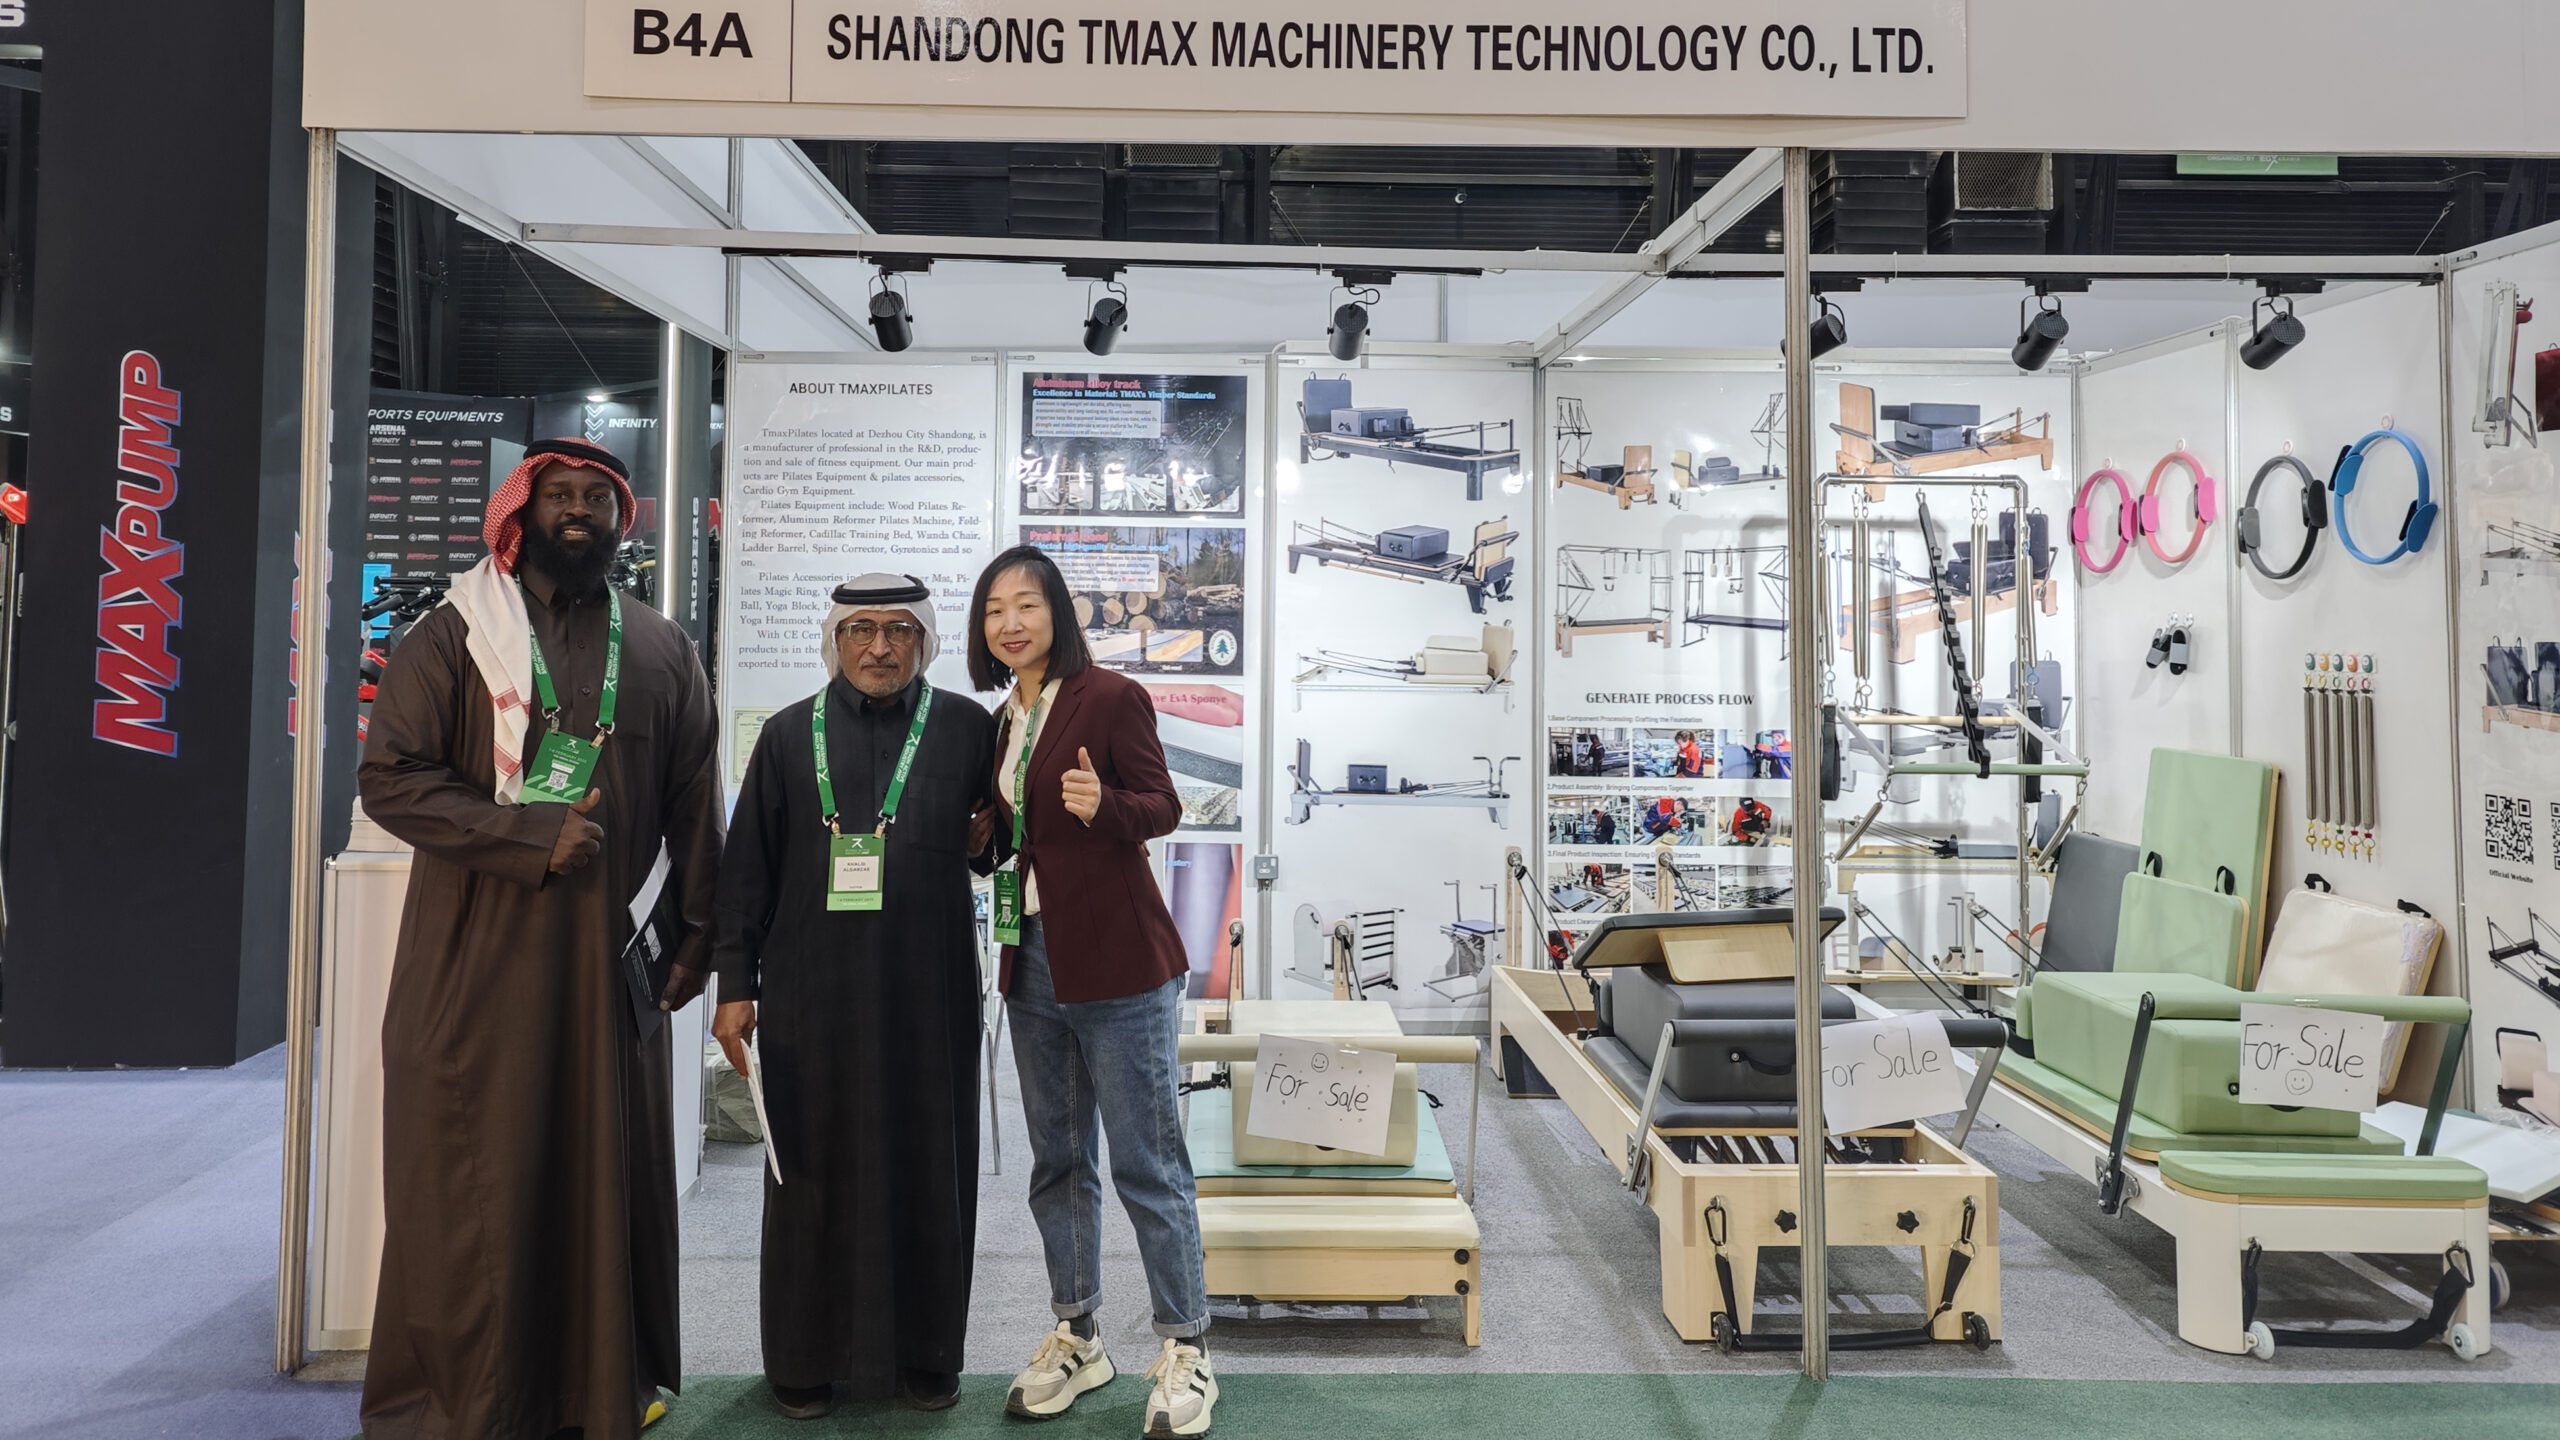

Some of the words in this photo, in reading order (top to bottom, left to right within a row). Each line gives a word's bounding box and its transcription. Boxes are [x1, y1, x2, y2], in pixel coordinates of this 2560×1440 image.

[633, 8, 753, 58] B4A
[826, 14, 1064, 64] SHANDONG
[1078, 18, 1199, 67] TMAX
[1212, 21, 1453, 71] MACHINERY
[1466, 23, 1747, 72] TECHNOLOGY
[1760, 23, 1837, 79] CO.,
[1851, 26, 1934, 74] LTD.
[789, 382, 834, 395] ABOUT
[839, 383, 933, 395] TMAXPILATES
[1033, 389, 1073, 397] Excellence
[1176, 391, 1216, 400] Standards
[368, 409, 413, 420] PORTS
[416, 411, 504, 422] EQUIPMENTS
[609, 418, 657, 428] INFINITY
[762, 428, 817, 437] TmaxPilates
[822, 429, 853, 438] located
[856, 430, 864, 438] at
[869, 430, 902, 438] Dezhou
[906, 430, 925, 440] City
[928, 430, 976, 440] Shandong,
[753, 443, 813, 452] manufacturer
[817, 444, 826, 452] of
[829, 444, 882, 454] professional
[899, 445, 914, 453] the
[918, 445, 944, 454] R&D,
[947, 445, 981, 454] produc-
[744, 457, 761, 466] tion
[765, 458, 782, 466] and
[785, 458, 802, 466] sale
[806, 458, 816, 466] of
[818, 458, 847, 466] fitness
[850, 460, 901, 468] equipment.
[904, 459, 923, 467] Our
[953, 459, 976, 469] prod-
[743, 473, 761, 481] ucts
[783, 472, 812, 481] Pilates
[817, 472, 866, 483] Equipment
[870, 473, 878, 481] &
[881, 473, 911, 483] pilates
[914, 474, 965, 483] accessories,
[743, 485, 774, 495] Cardio
[777, 486, 798, 497] Gym
[803, 486, 855, 497] Equipment.
[761, 500, 791, 509] Pilates
[795, 501, 845, 511] Equipment
[848, 501, 885, 510] include:
[888, 501, 914, 510] Wood
[918, 501, 948, 510] Pilates
[952, 502, 966, 510] Re-
[742, 515, 776, 525] former,
[779, 515, 828, 524] Aluminum
[833, 515, 875, 524] Reformer
[880, 516, 909, 524] Pilates
[913, 516, 955, 526] Machine,
[958, 517, 981, 525] Fold-
[742, 529, 757, 539] ing
[760, 529, 806, 539] Reformer,
[809, 529, 846, 538] Cadillac
[849, 530, 889, 540] Training
[893, 530, 913, 540] Bed,
[952, 531, 981, 540] Chair,
[92, 350, 184, 758] MAXPUMP
[742, 543, 774, 552] Ladder
[777, 544, 809, 554] Barrel,
[812, 544, 838, 554] Spine
[842, 544, 887, 554] Corrector,
[891, 545, 939, 555] Gyrotonics
[942, 545, 959, 554] and
[741, 559, 756, 567] on.
[759, 572, 789, 581] Pilates
[792, 573, 843, 581] Accessories
[932, 574, 953, 582] Mat,
[956, 574, 970, 582] Pi-
[741, 587, 761, 595] lates
[764, 587, 792, 596] Magic
[796, 588, 820, 597] Ring,
[741, 602, 762, 610] Ball,
[766, 602, 788, 611] Yoga
[792, 602, 820, 611] Block,
[936, 603, 964, 611] Aerial
[740, 616, 762, 625] Yoga
[766, 616, 814, 625] Hammock
[757, 630, 780, 639] With
[784, 631, 798, 639] CE
[952, 632, 962, 641] of
[739, 645, 777, 655] products
[738, 659, 778, 669] exported
[1152, 694, 1166, 703] ive
[1586, 693, 1651, 705] GENERATE
[1655, 694, 1714, 706] PROCESS
[1718, 694, 1755, 706] FLOW
[2489, 869, 2510, 880] Official
[2511, 873, 2534, 883] Website
[1871, 1026, 1940, 1081] Sale
[2241, 1022, 2290, 1072] For
[2296, 1023, 2365, 1078] Sale
[1266, 1062, 1309, 1099] For
[1324, 1082, 1369, 1112] Sale
